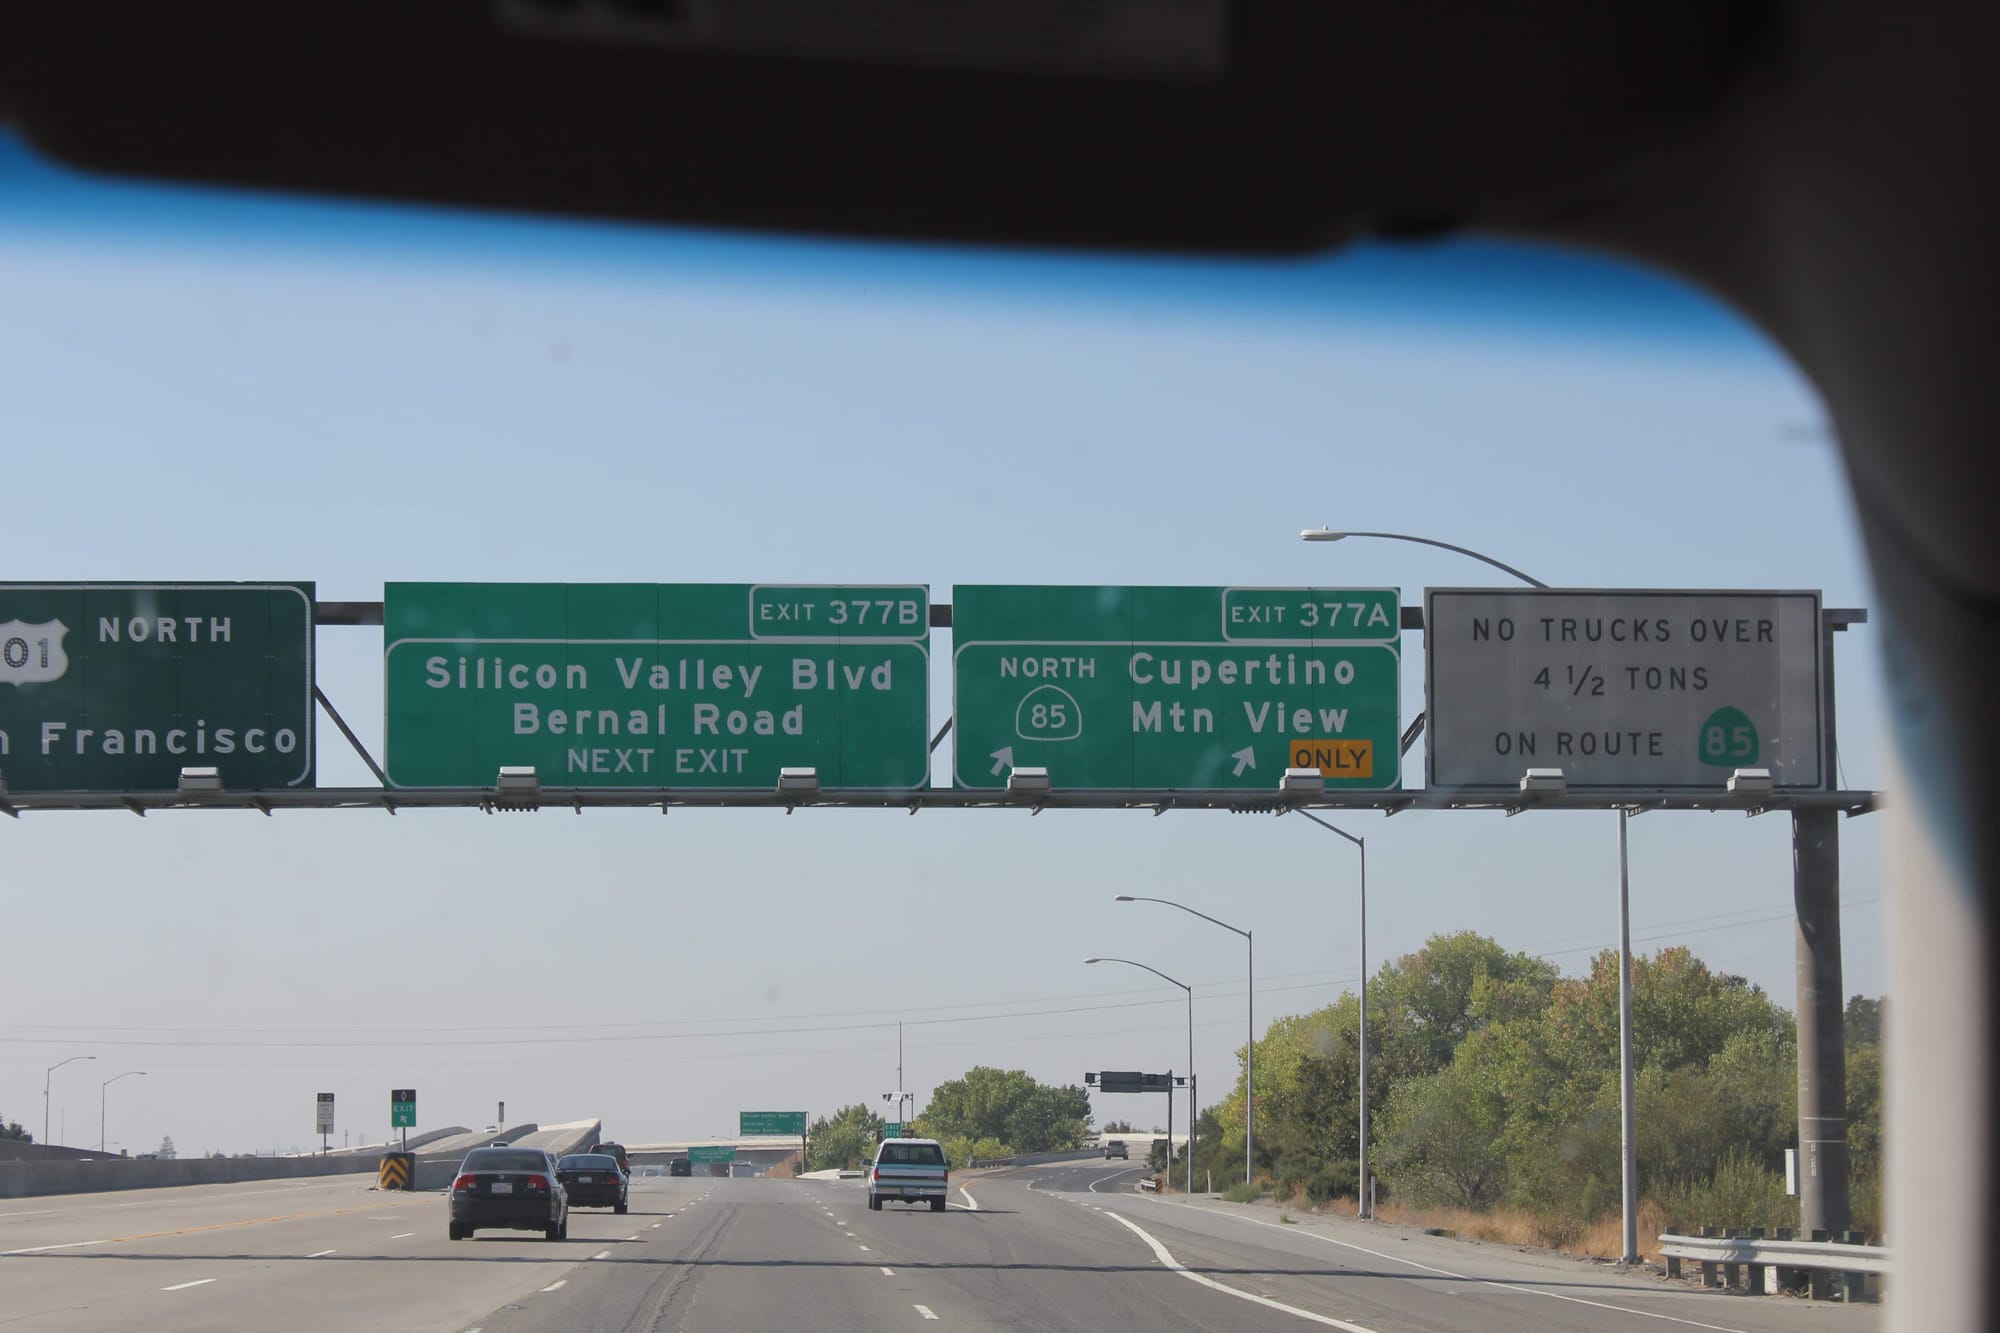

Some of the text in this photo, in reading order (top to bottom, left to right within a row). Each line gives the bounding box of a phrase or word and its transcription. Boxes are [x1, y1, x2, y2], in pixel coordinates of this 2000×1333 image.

[760, 599, 919, 625] EXIT 377B
[1231, 602, 1390, 627] EXIT 377A
[99, 616, 231, 643] NORTH
[1473, 617, 1774, 643] NO TRUCKS OVER
[3, 636, 49, 669] 01
[425, 656, 892, 699] Silicon Valley Blvd
[1000, 656, 1095, 679] NORTH
[1128, 652, 1355, 691] Cupertino
[1533, 666, 1551, 690] 4
[1625, 666, 1709, 691] TONS
[513, 702, 803, 736] Bernal Road
[1031, 703, 1067, 729] 85
[1132, 700, 1349, 734] Mtn View
[41, 719, 296, 755] Francisco
[1495, 731, 1664, 757] ON ROUTE
[1706, 725, 1752, 757] 85
[567, 748, 749, 774] NEXT EXIT
[1295, 748, 1367, 769] ONLY
